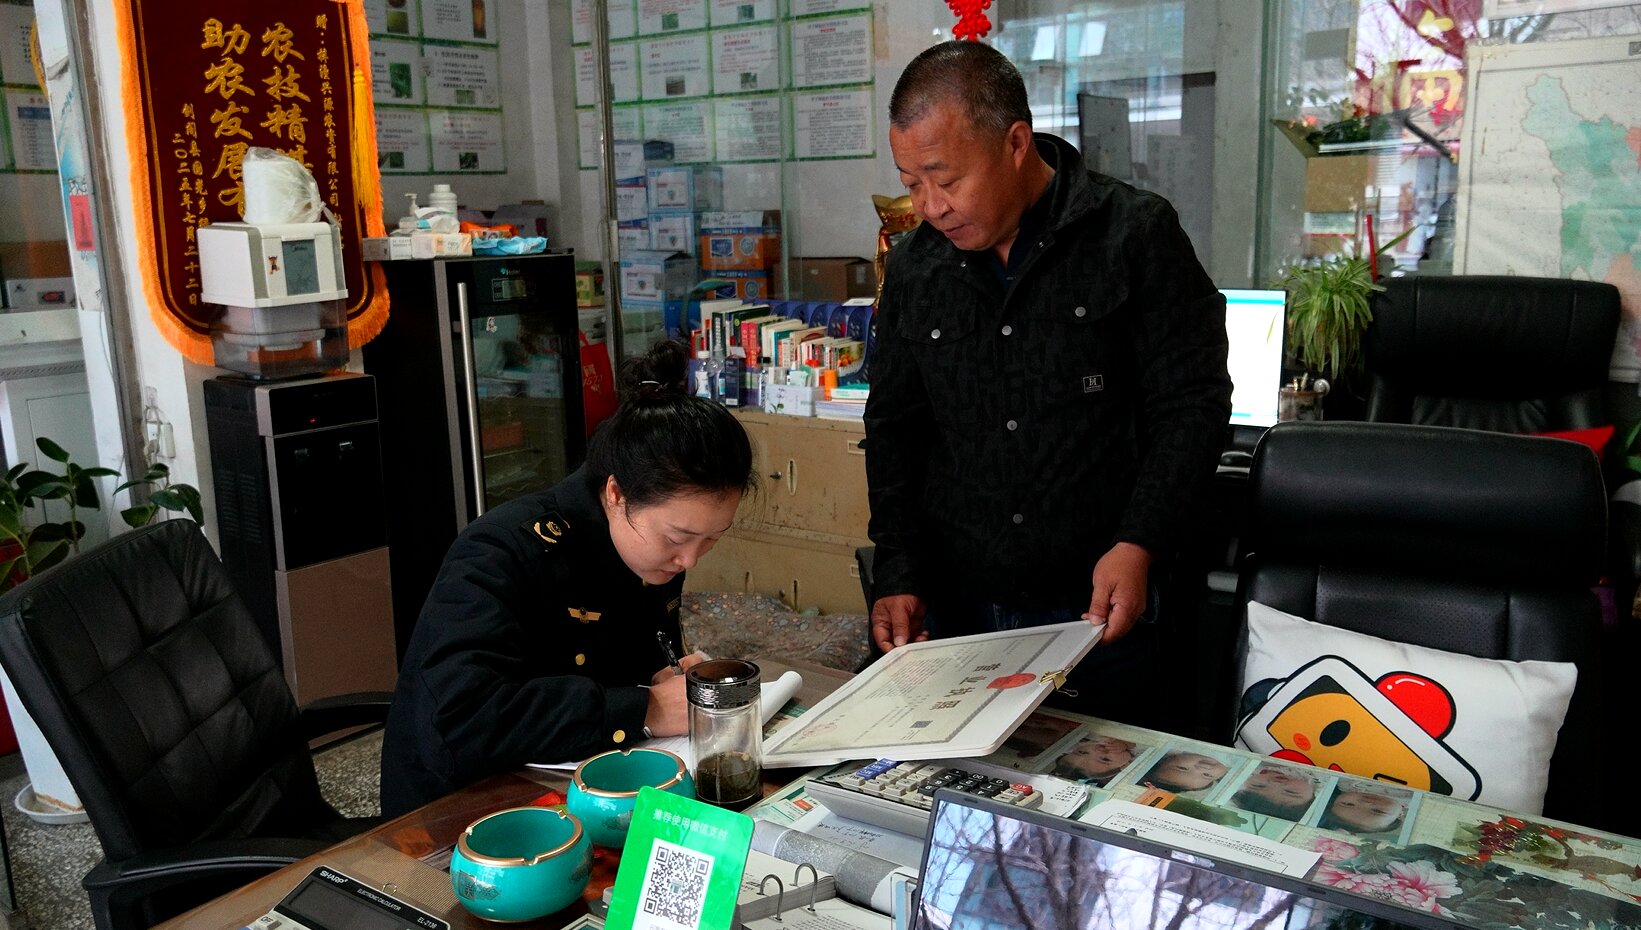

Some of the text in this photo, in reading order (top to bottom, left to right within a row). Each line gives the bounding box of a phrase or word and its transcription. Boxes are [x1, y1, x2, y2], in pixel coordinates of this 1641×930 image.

[652, 808, 729, 841] 推荐使用微信支付
[319, 869, 345, 885] SHARP
[356, 887, 402, 912] ELECTRONIC CALCULATOR
